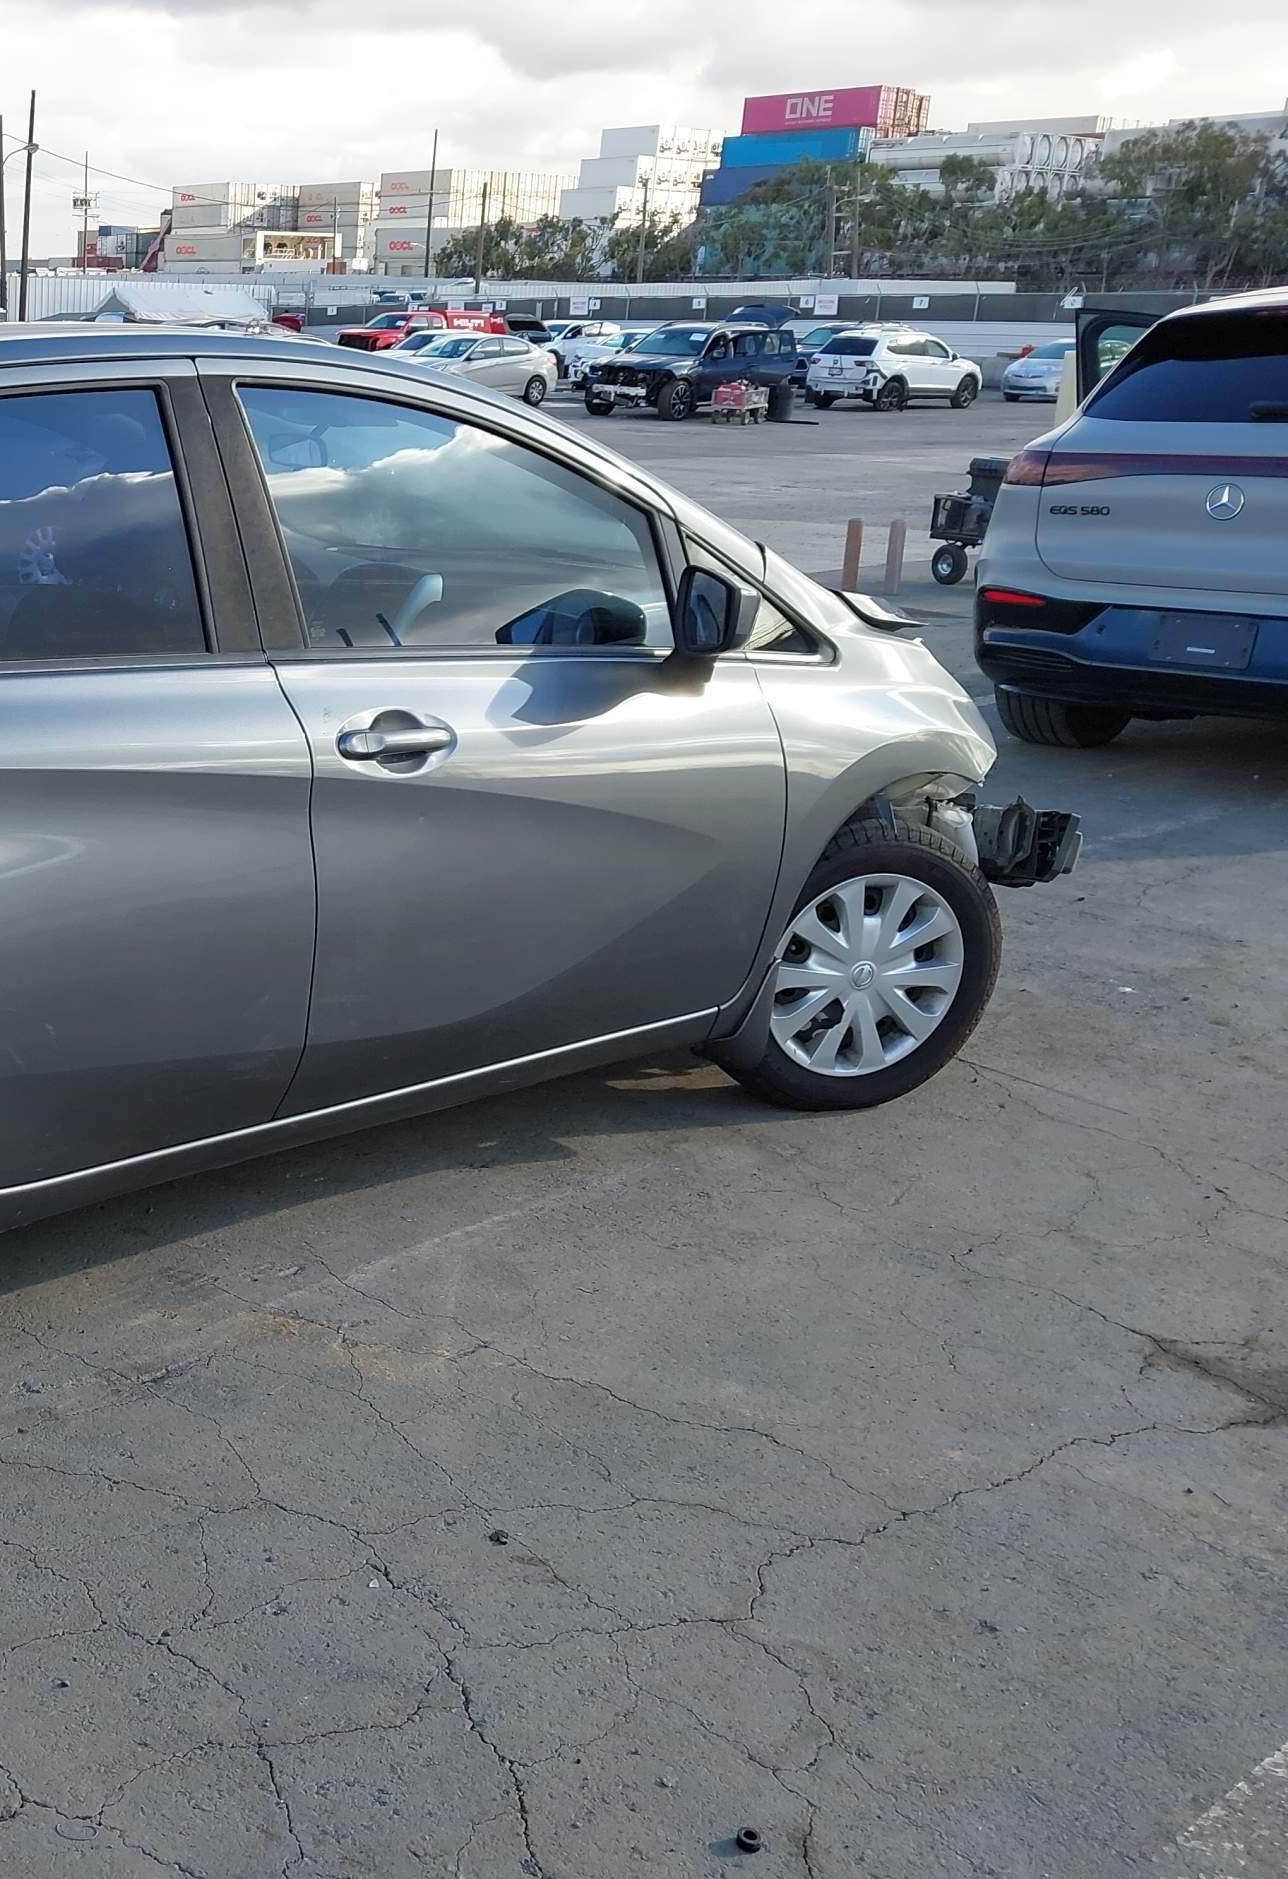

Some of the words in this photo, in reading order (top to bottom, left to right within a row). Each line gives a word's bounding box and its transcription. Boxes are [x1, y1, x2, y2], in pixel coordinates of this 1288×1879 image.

[785, 95, 835, 119] ONE
[1049, 505, 1078, 515] EQS
[1080, 506, 1110, 516] 580
